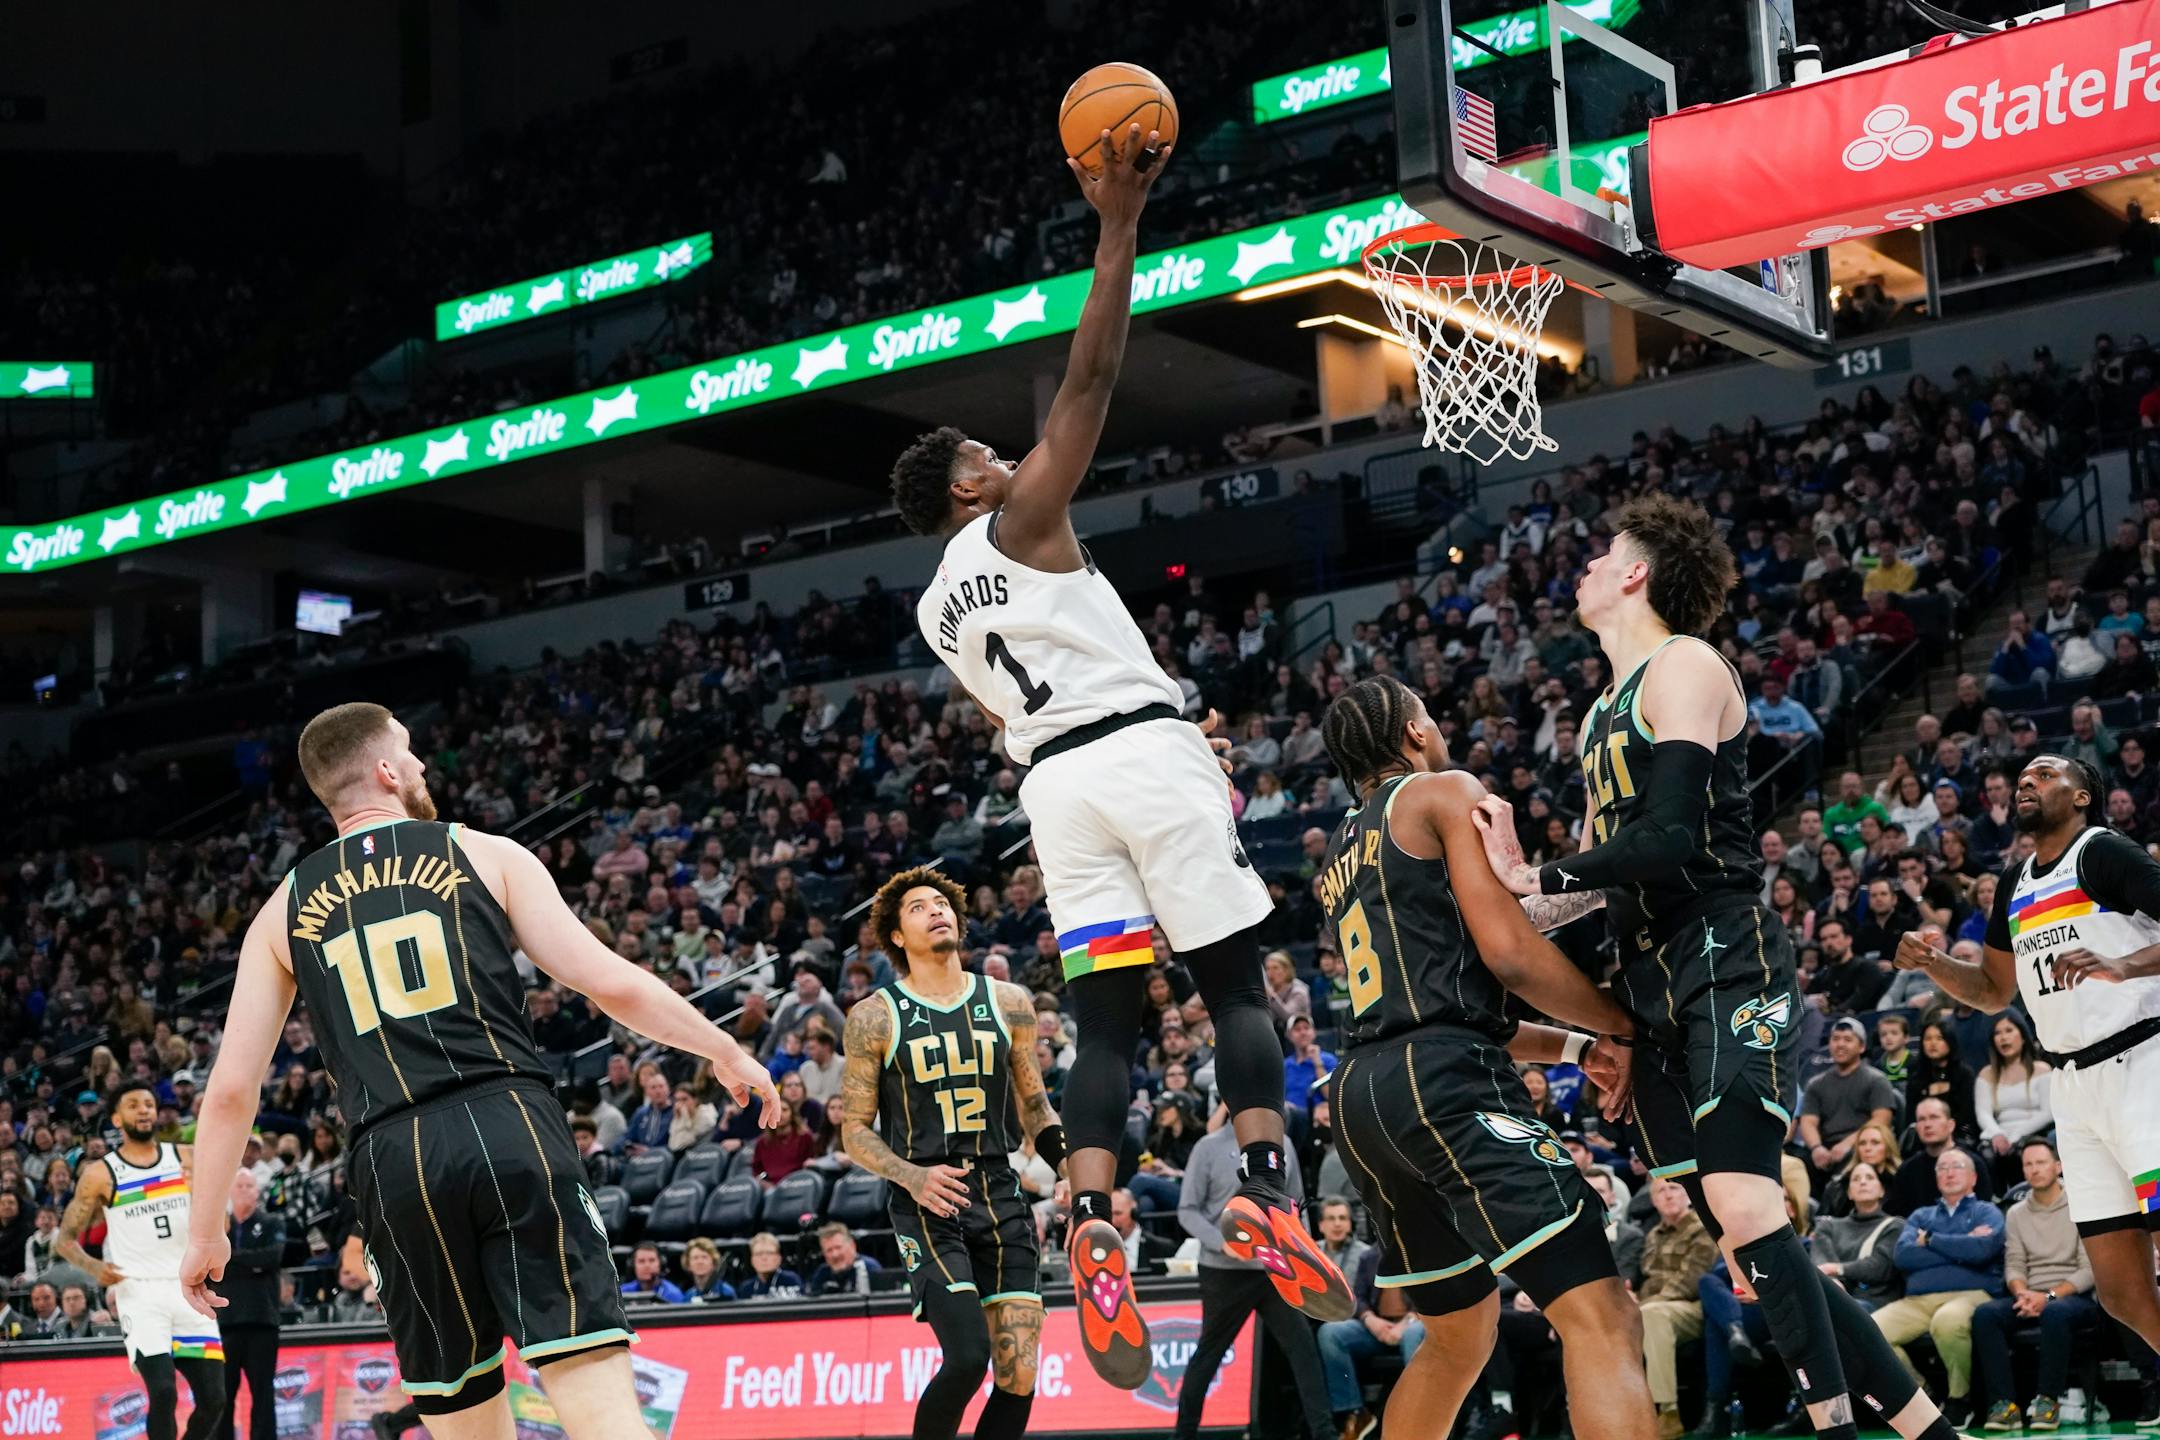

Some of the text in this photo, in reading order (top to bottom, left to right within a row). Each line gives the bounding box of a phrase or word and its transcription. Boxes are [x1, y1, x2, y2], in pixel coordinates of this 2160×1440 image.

[1280, 66, 1361, 113] Sprite
[1884, 180, 2048, 229] State
[456, 261, 640, 332] Sprite Sprite
[1838, 346, 1882, 377] 131
[7, 526, 84, 570] Sprite
[155, 492, 225, 539] Sprite
[329, 449, 404, 498] Sprite
[486, 409, 567, 461] Sprite
[686, 359, 773, 414] Sprite
[868, 314, 962, 370] Sprite
[1131, 253, 1205, 304] prite
[1219, 473, 1260, 501] 130
[702, 579, 734, 604] 129
[939, 574, 1008, 655] EDWARDS
[985, 631, 1053, 716] 1
[292, 854, 471, 943] MYKHAILIUK
[1320, 842, 1360, 917] SMITH
[1338, 898, 1383, 1018] 8
[2015, 924, 2080, 959] MINNESOTA
[321, 909, 459, 1036] 10
[906, 1029, 998, 1084] CLT
[934, 1086, 987, 1134] 12
[153, 1214, 172, 1239] 9
[720, 1354, 805, 1410] Feed
[811, 1351, 894, 1407] Your
